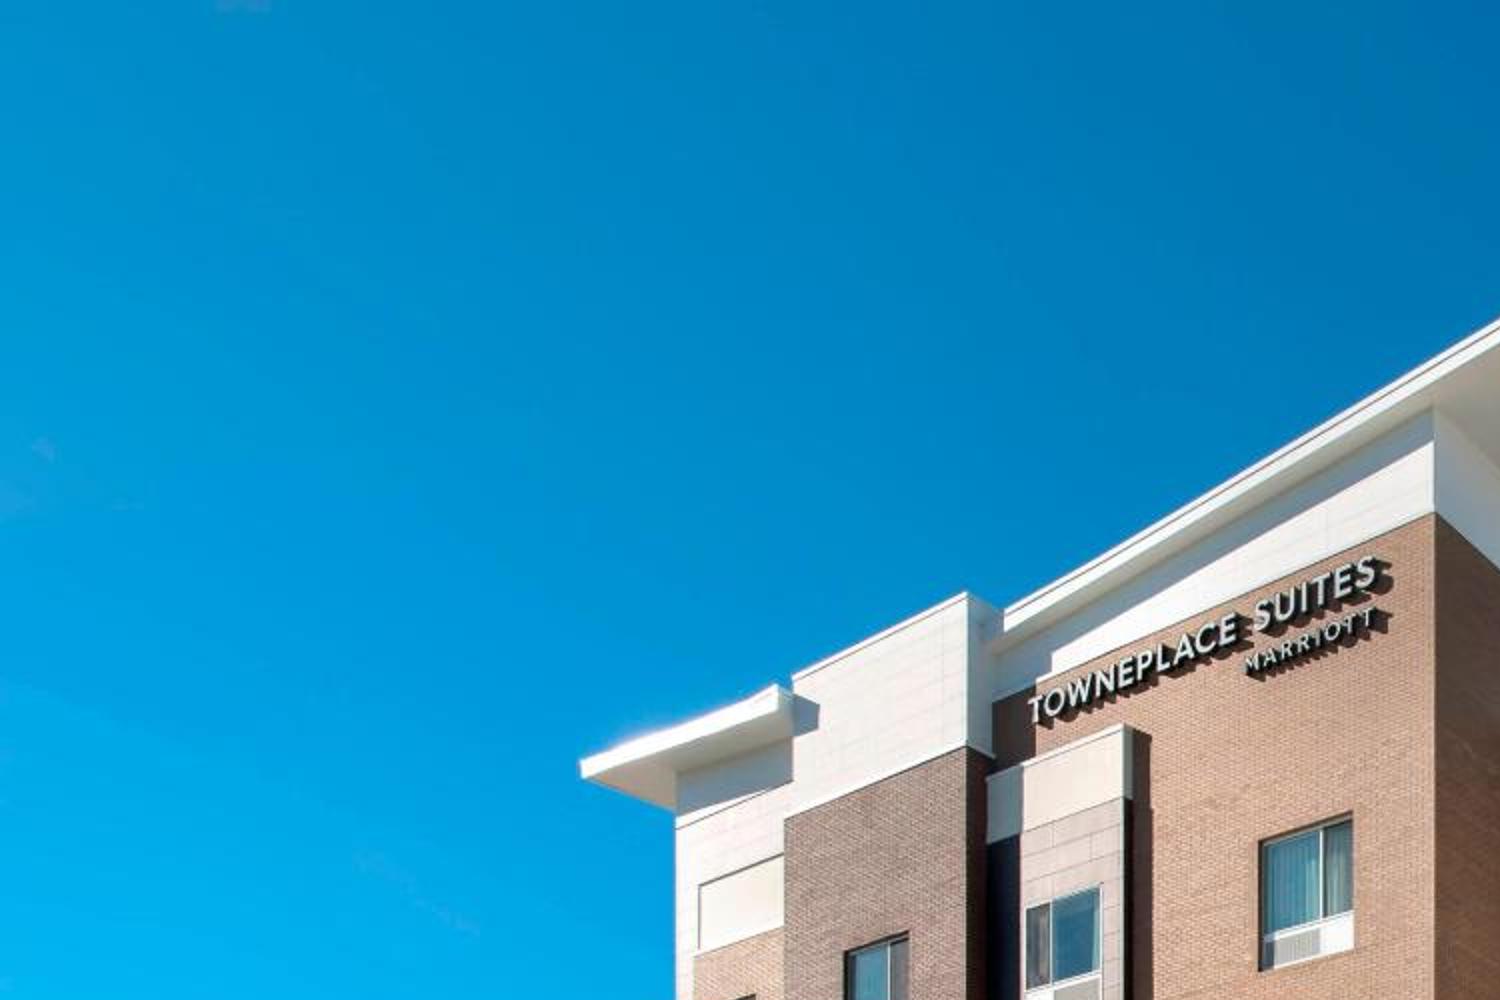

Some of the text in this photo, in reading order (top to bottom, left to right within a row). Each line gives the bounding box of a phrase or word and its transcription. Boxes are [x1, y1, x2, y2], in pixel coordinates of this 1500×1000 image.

[1027, 555, 1378, 724] TOWNEPLACE SUITES
[1243, 606, 1377, 673] MARRIOTT
